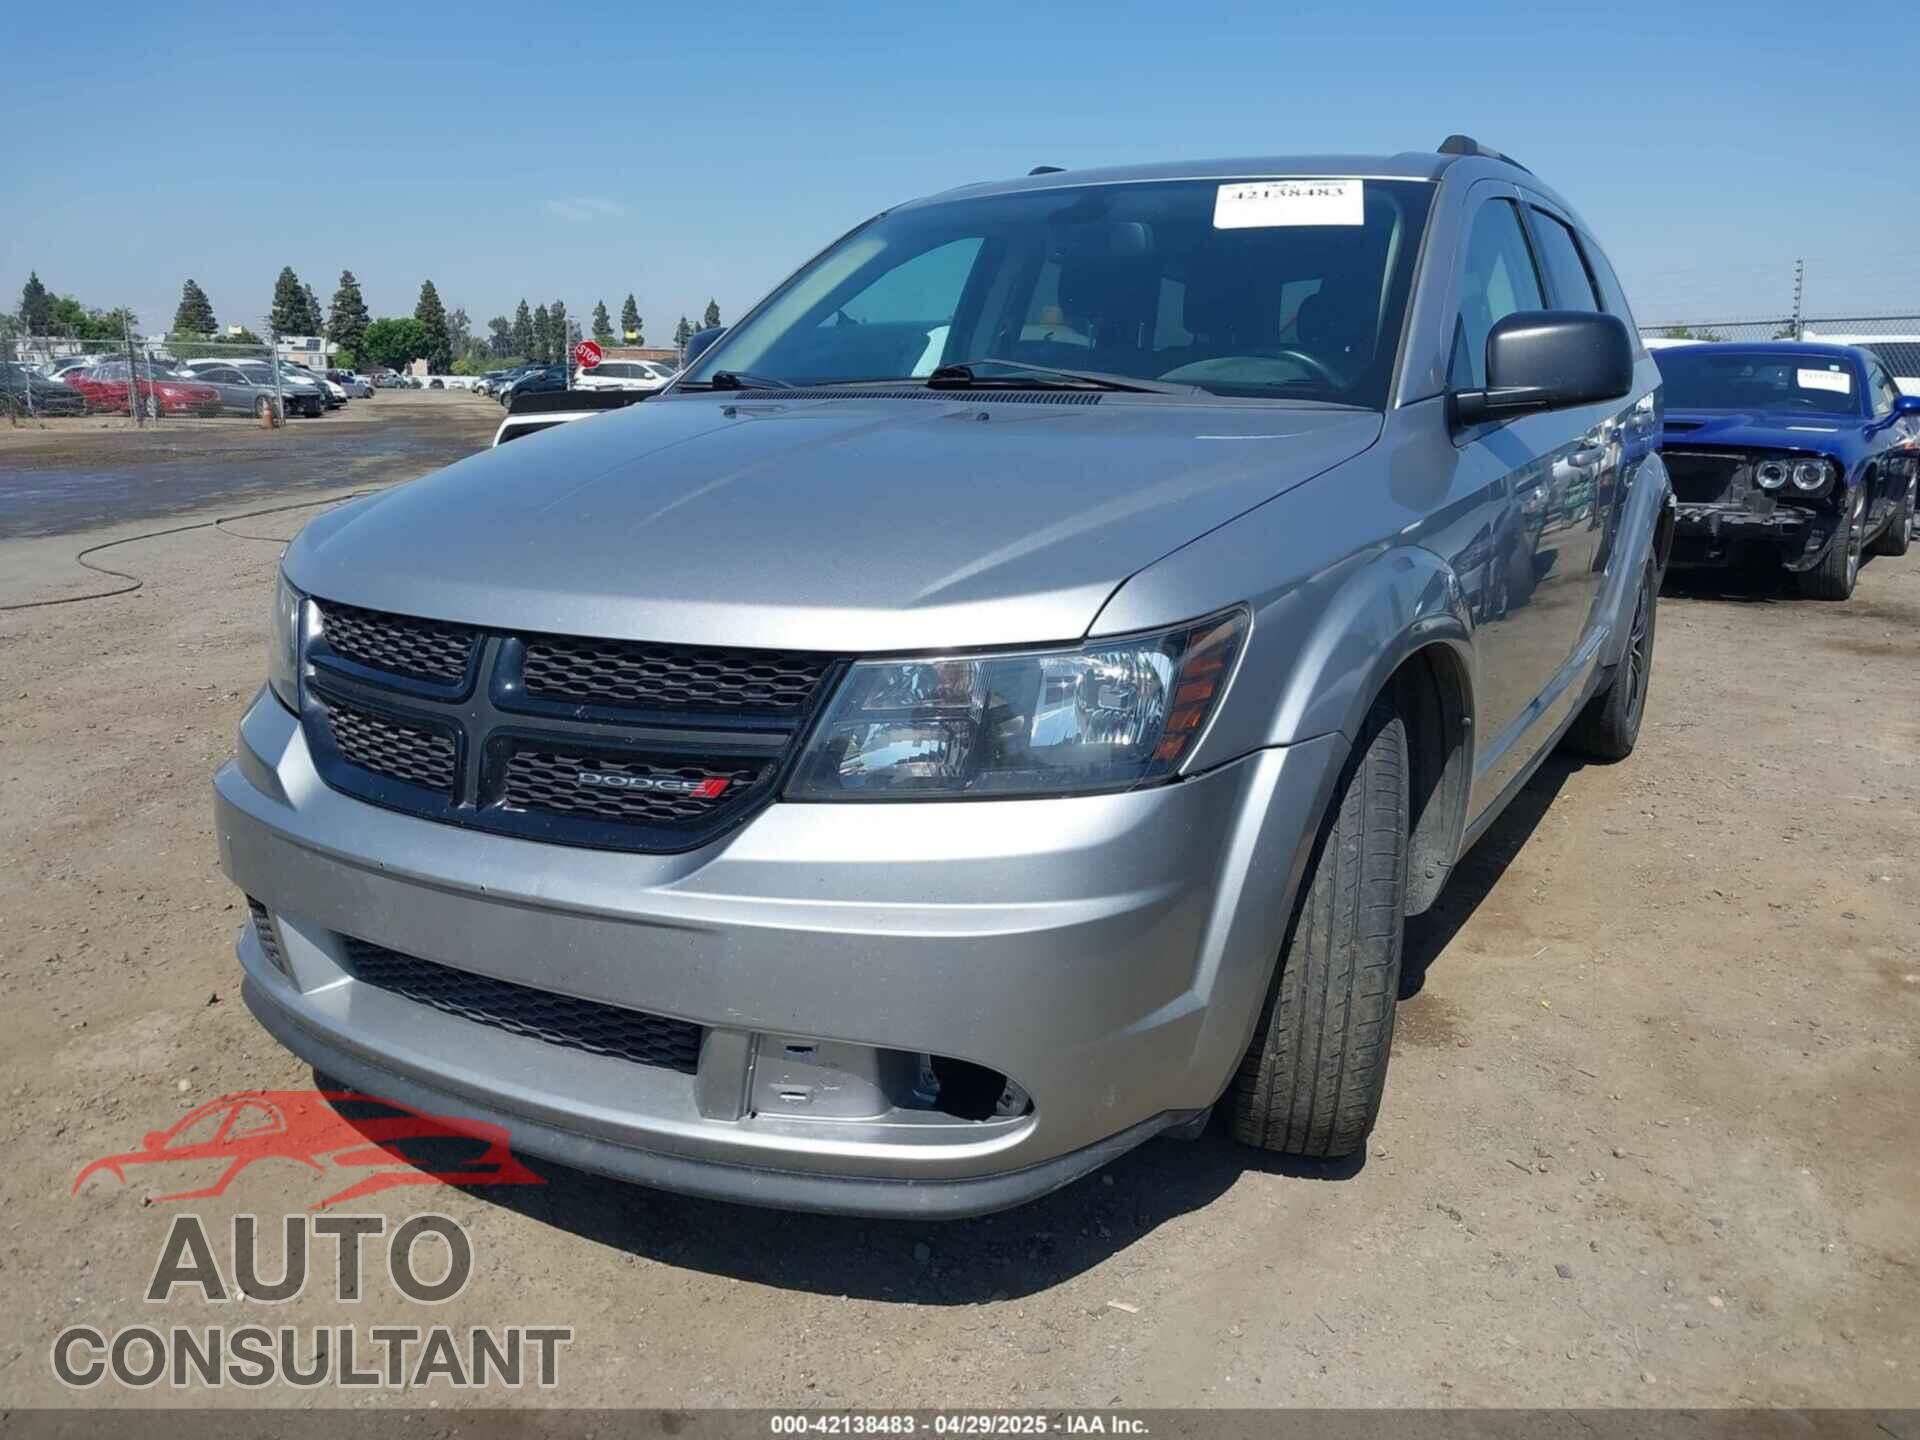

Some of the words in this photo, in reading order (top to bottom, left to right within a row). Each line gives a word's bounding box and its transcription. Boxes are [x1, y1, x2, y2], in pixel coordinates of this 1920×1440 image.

[1232, 188, 1344, 200] 42138483
[577, 344, 600, 362] STOP
[579, 773, 707, 792] DODGE
